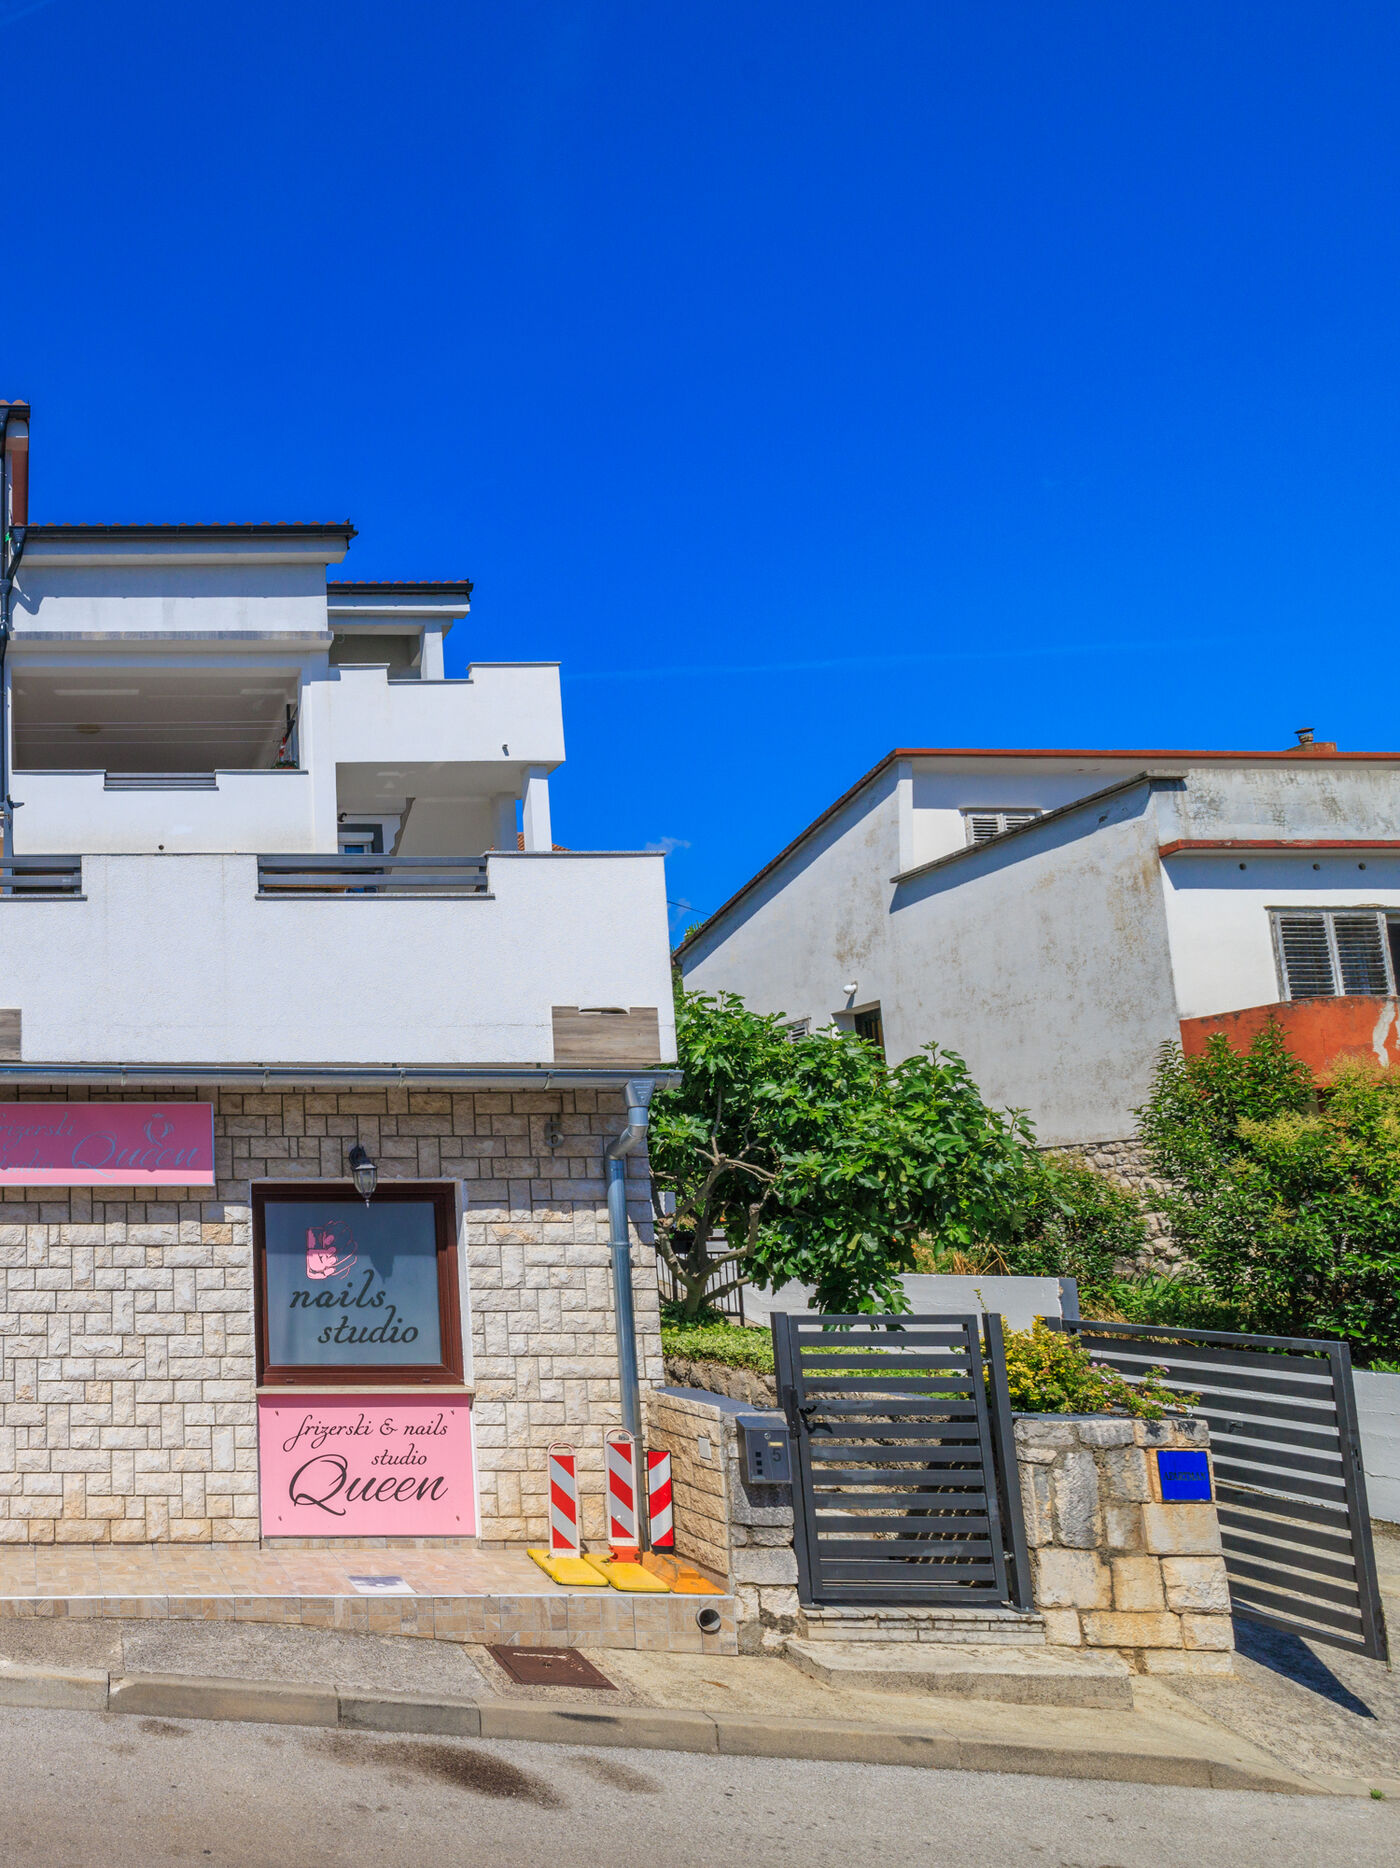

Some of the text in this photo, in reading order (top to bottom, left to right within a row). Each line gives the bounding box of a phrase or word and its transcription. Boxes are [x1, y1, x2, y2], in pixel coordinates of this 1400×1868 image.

[71, 1130, 201, 1178] Queen
[289, 1268, 386, 1308] nails
[317, 1304, 419, 1344] studio
[282, 1413, 448, 1453] frizerski & nails
[371, 1443, 428, 1466] studio
[772, 1447, 782, 1462] 5
[288, 1453, 449, 1516] Queen
